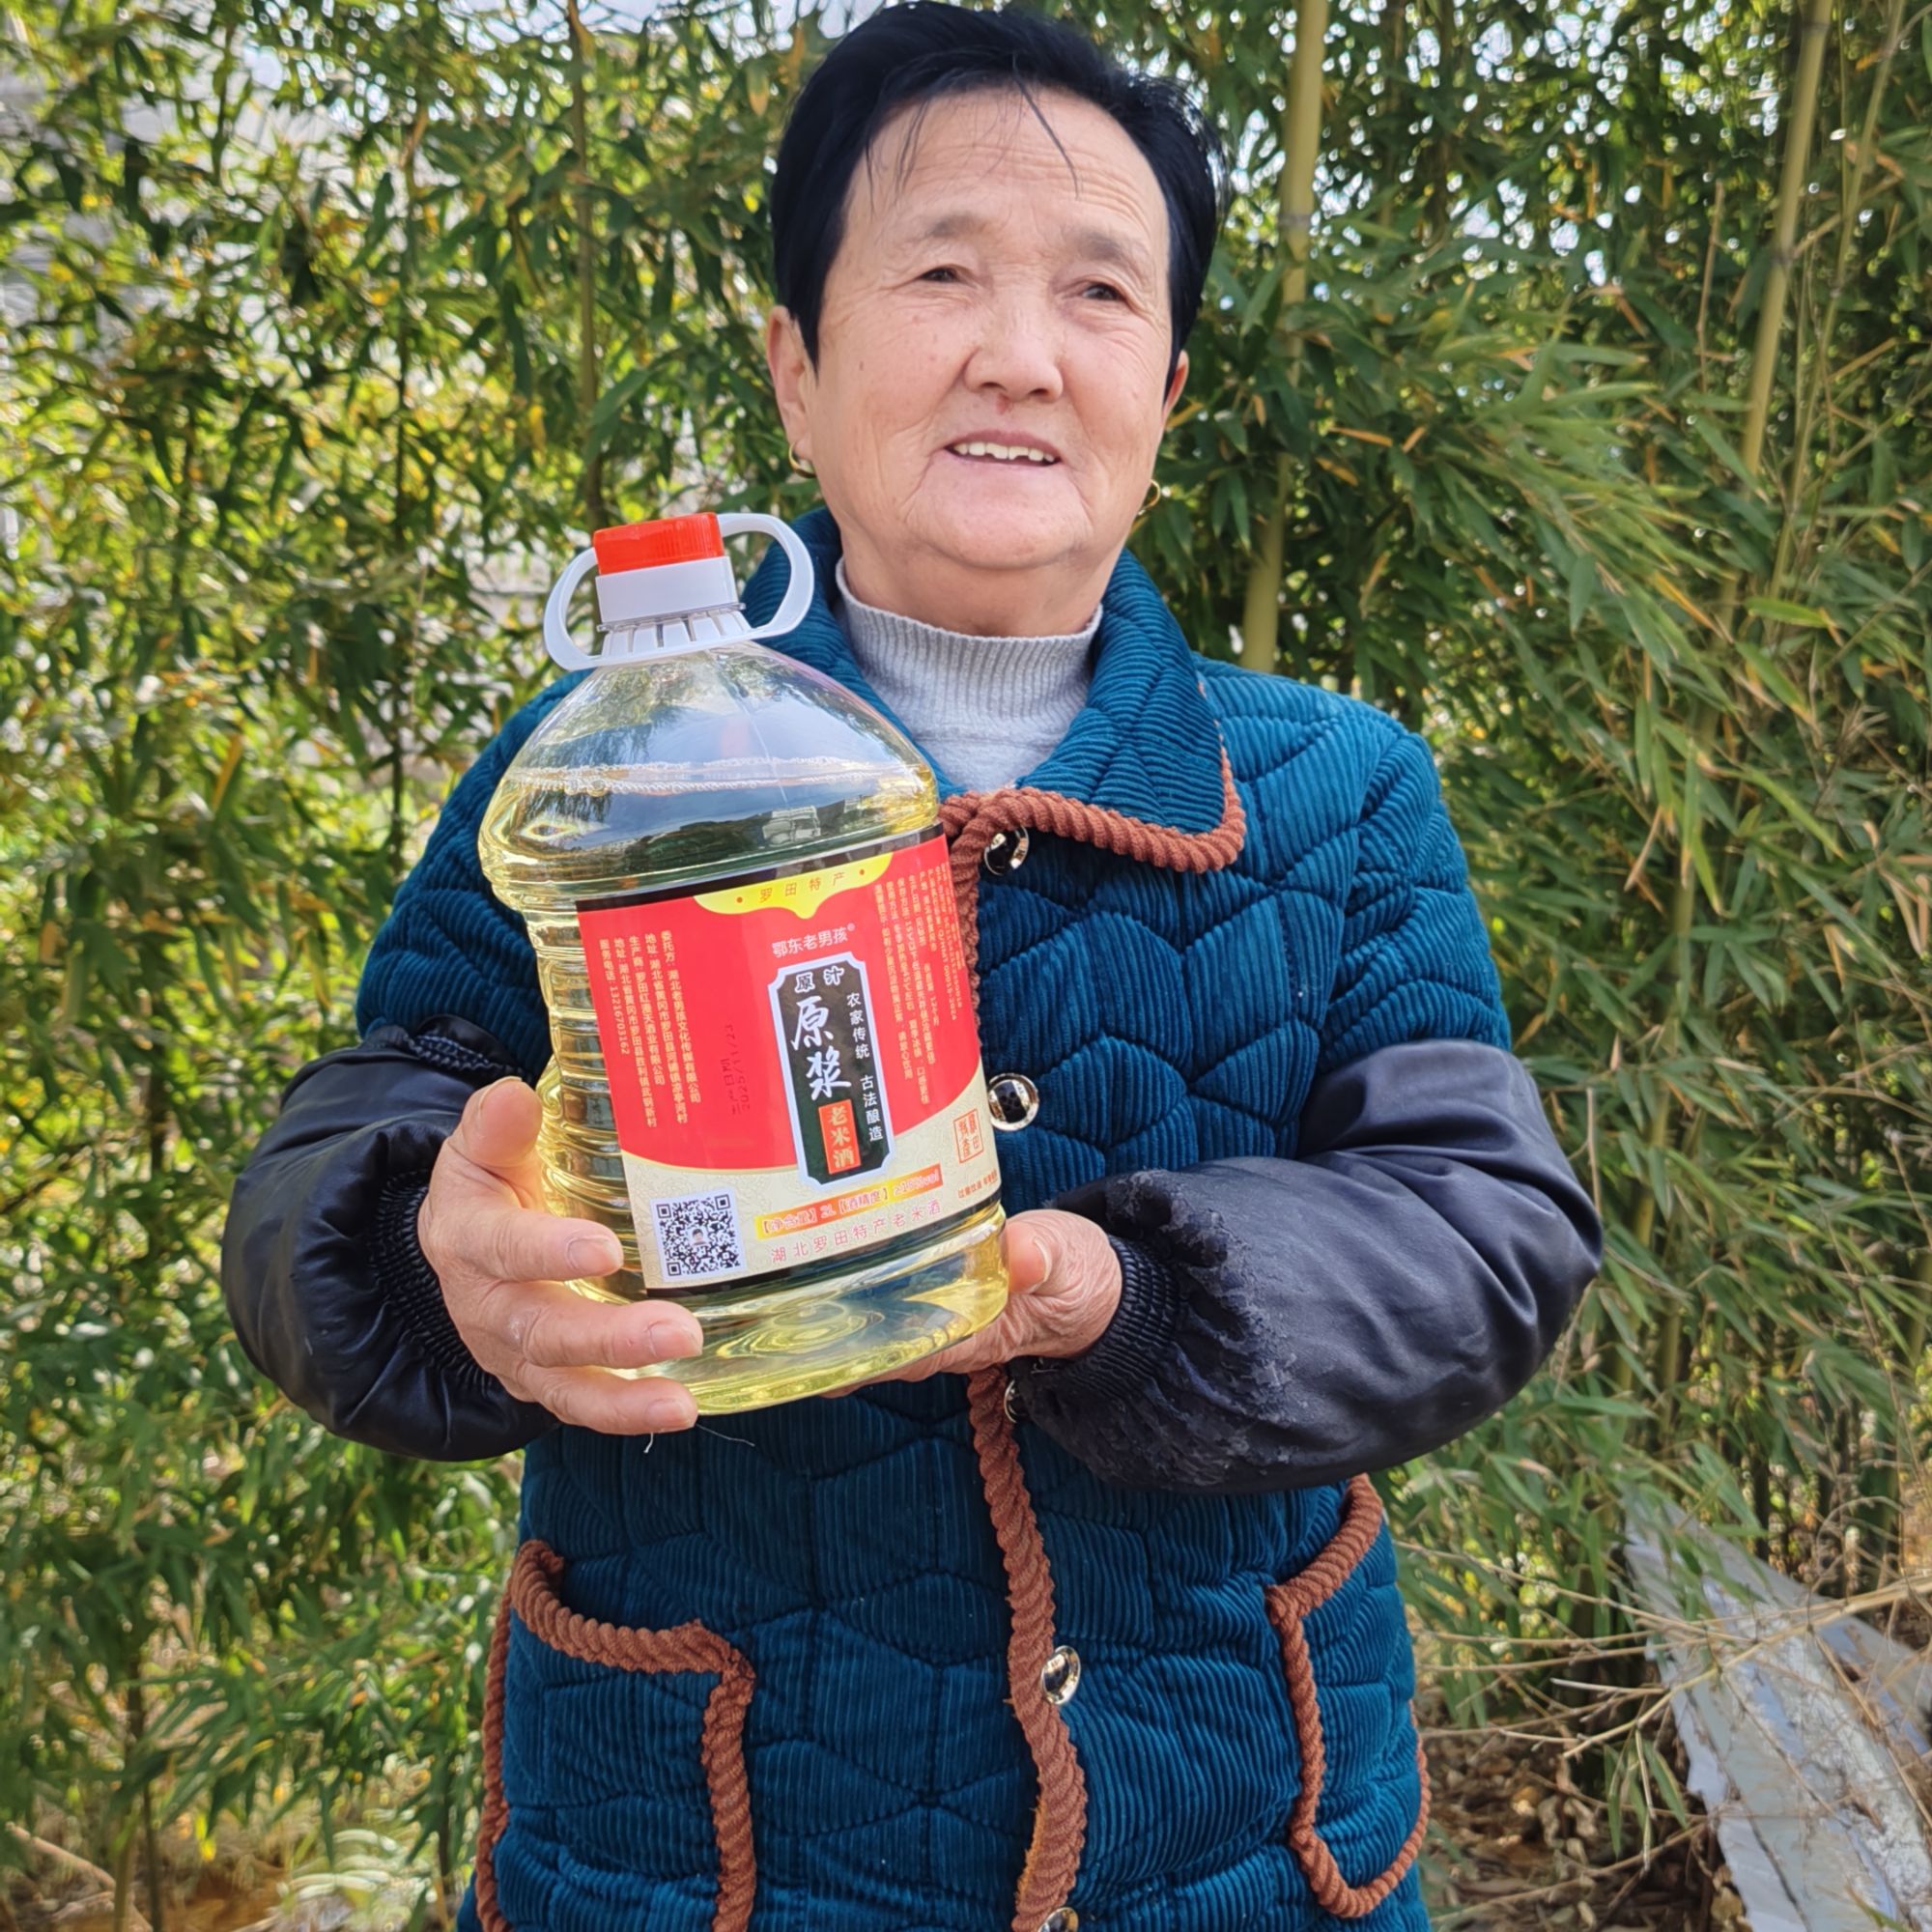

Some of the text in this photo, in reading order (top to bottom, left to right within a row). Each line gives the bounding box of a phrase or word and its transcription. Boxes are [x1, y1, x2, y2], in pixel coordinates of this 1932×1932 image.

[759, 871, 845, 903] 罗田特产
[772, 926, 849, 958] 鄂东老男孩
[795, 966, 845, 994] 原汁
[790, 995, 852, 1101] 原浆
[846, 992, 884, 1142] 农家传统 古法酿造
[828, 1106, 855, 1169] 老米酒
[771, 1198, 942, 1264] 湖北罗田特产老米酒
